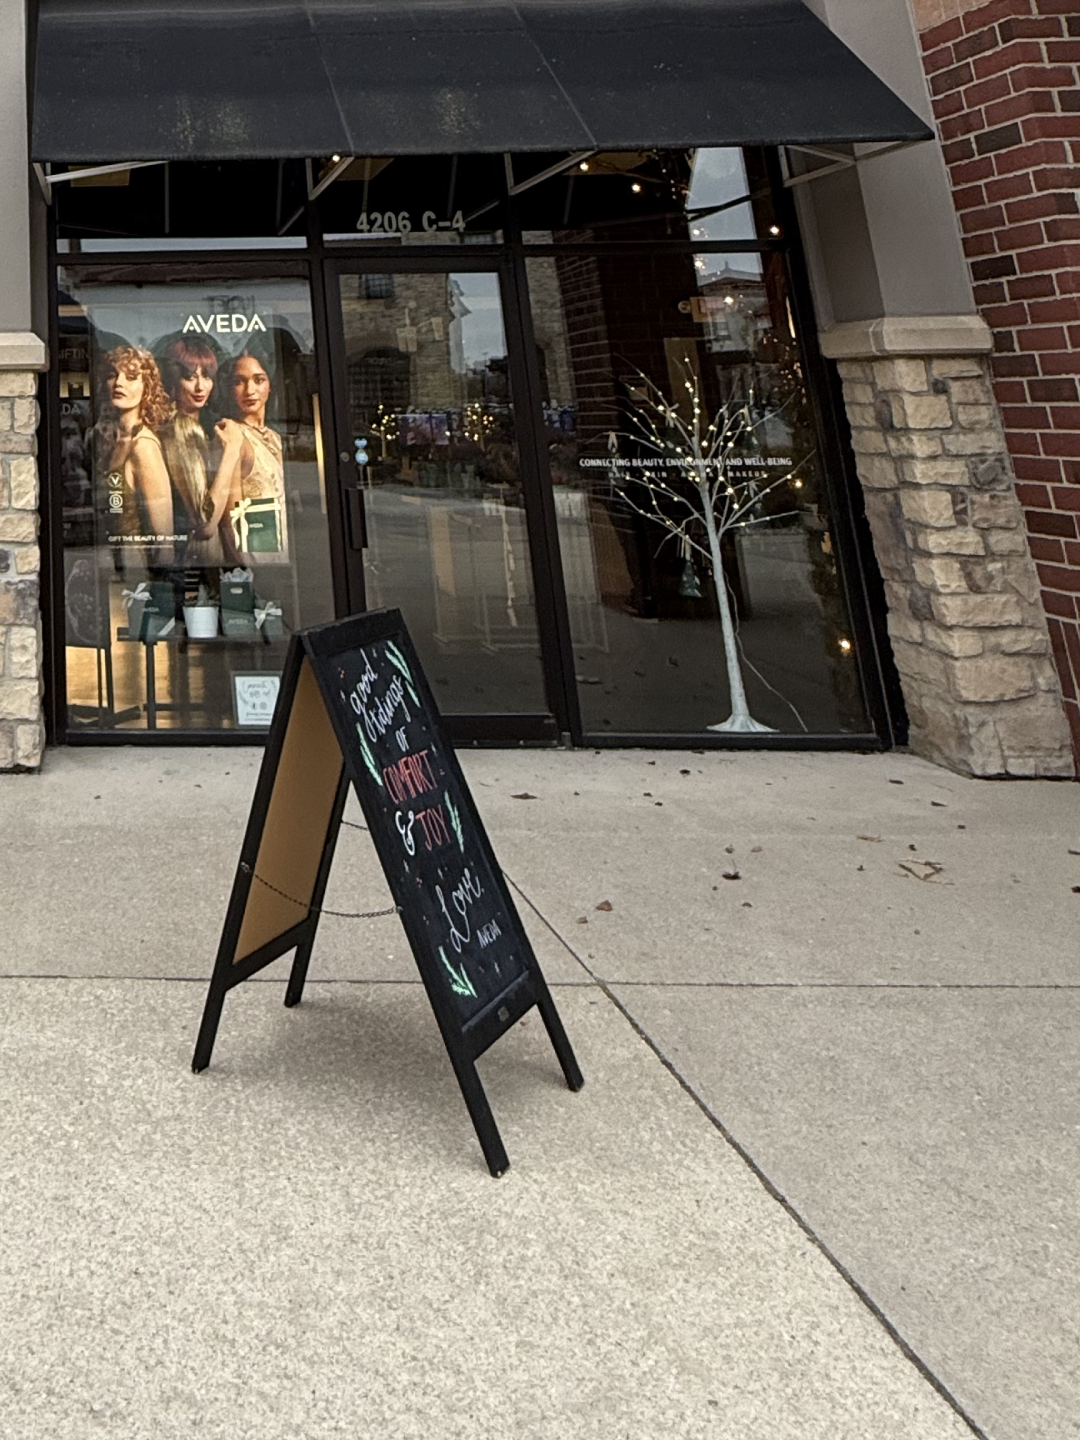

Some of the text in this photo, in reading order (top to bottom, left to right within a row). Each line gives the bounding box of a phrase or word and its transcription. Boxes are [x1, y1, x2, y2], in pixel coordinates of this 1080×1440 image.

[356, 210, 466, 234] 4206 C-4
[182, 313, 267, 334] AVEDA
[579, 458, 630, 467] CONNECTING
[725, 457, 743, 466] AND
[744, 457, 793, 466] WELL-BEING
[349, 648, 378, 743] good
[383, 750, 438, 805] COMFORT
[415, 805, 450, 851] JOY
